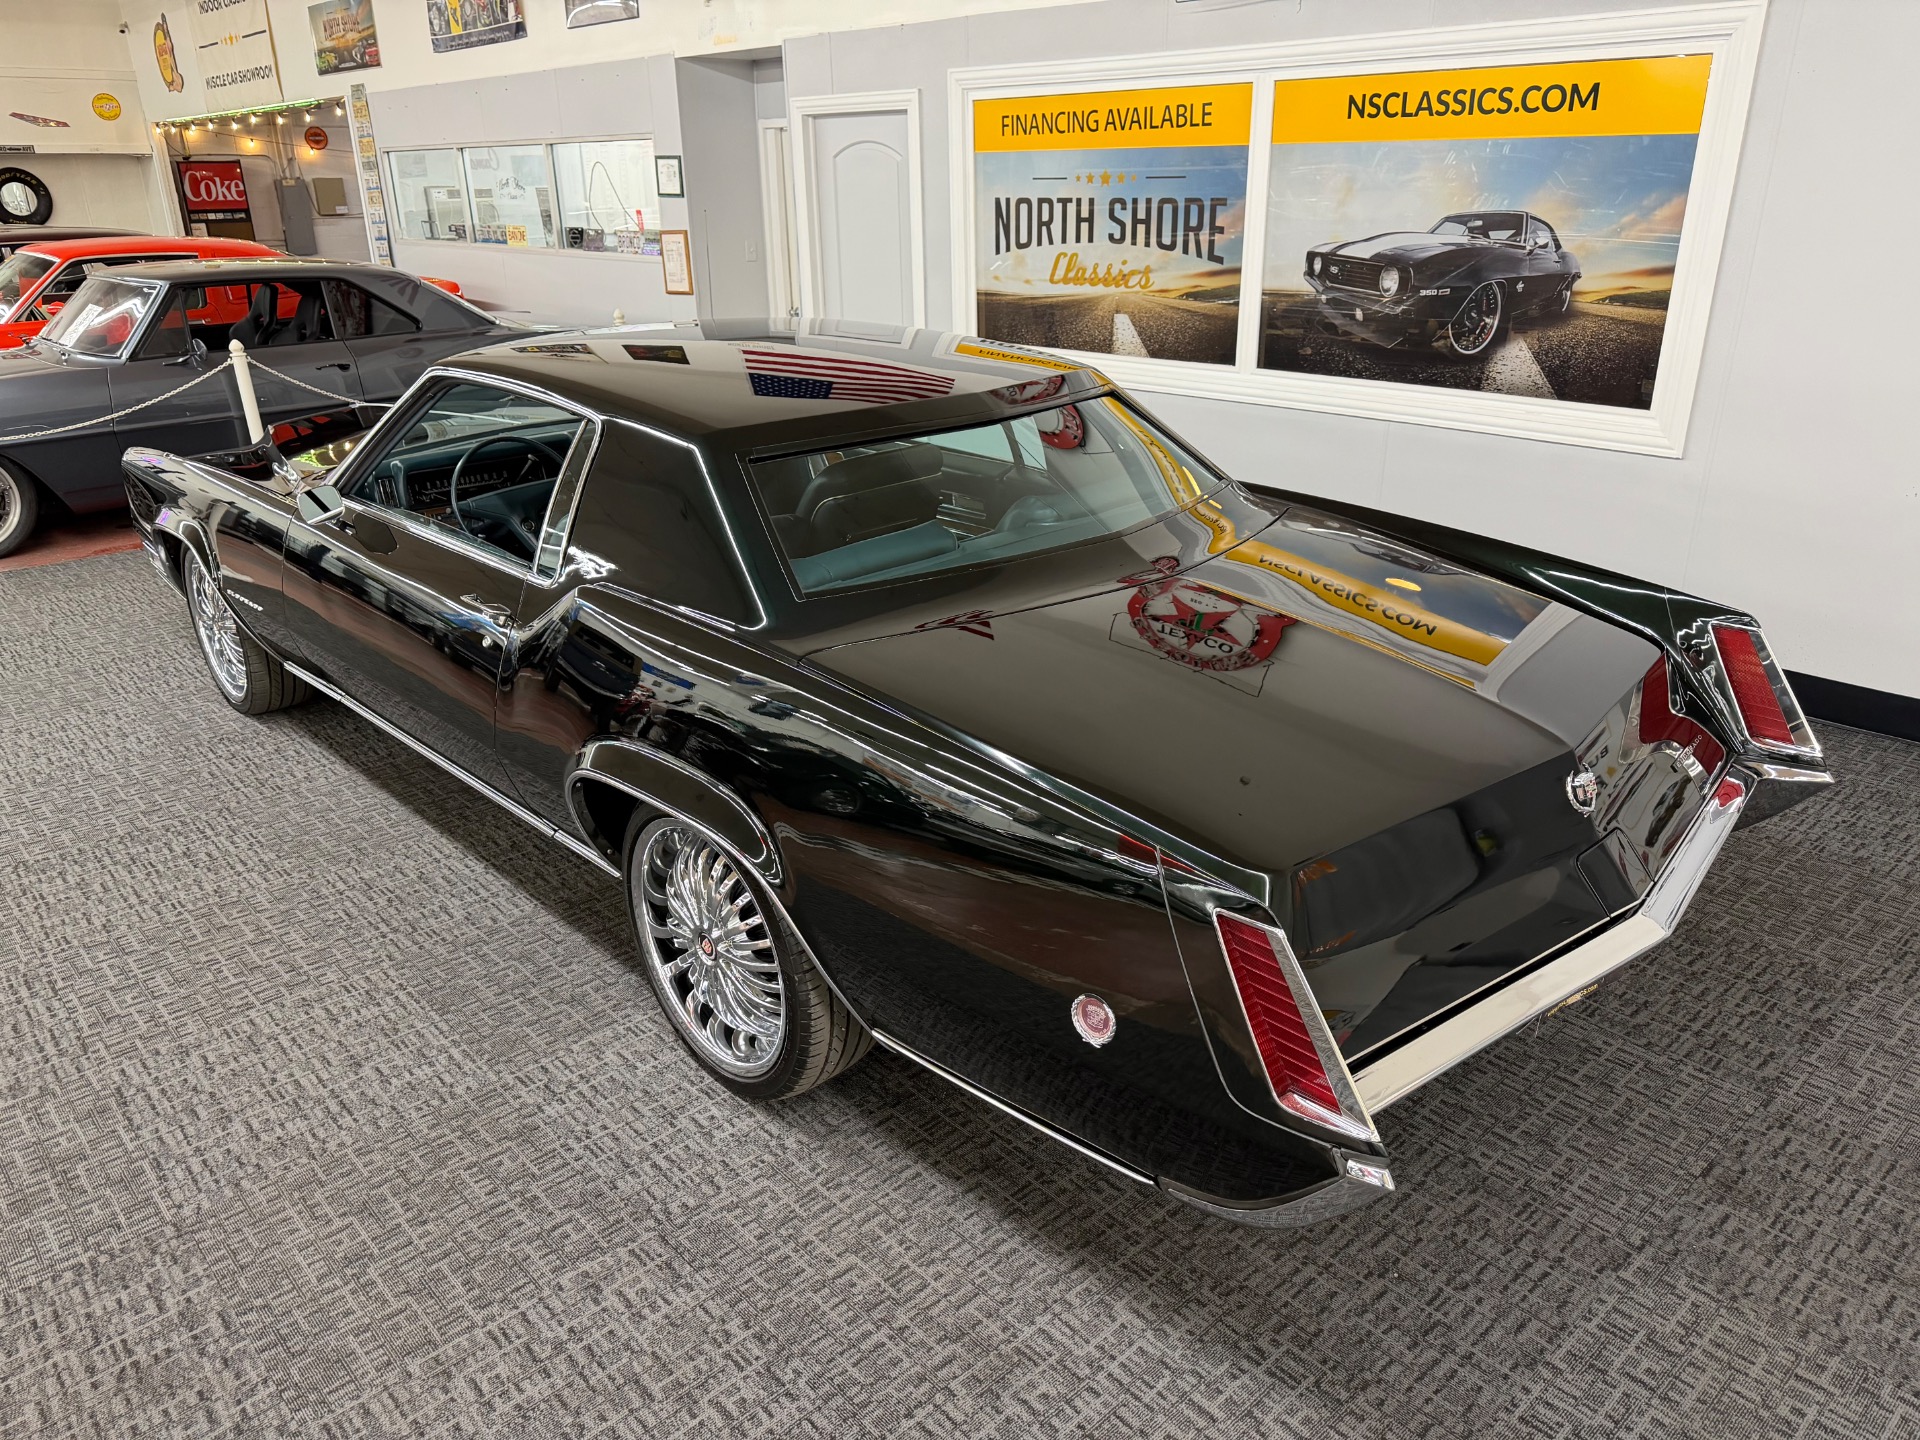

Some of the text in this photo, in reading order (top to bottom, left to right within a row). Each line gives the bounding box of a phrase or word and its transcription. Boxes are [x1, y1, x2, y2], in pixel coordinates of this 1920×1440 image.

[205, 64, 274, 90] MUSCLE CAR SHOWROOM
[1347, 82, 1600, 120] NSCLASSICS.COM
[1001, 102, 1213, 136] FINANCING AVAILABLE
[184, 171, 246, 202] Coke
[994, 197, 1228, 265] NORTH SHORE
[1049, 252, 1156, 289] Classics
